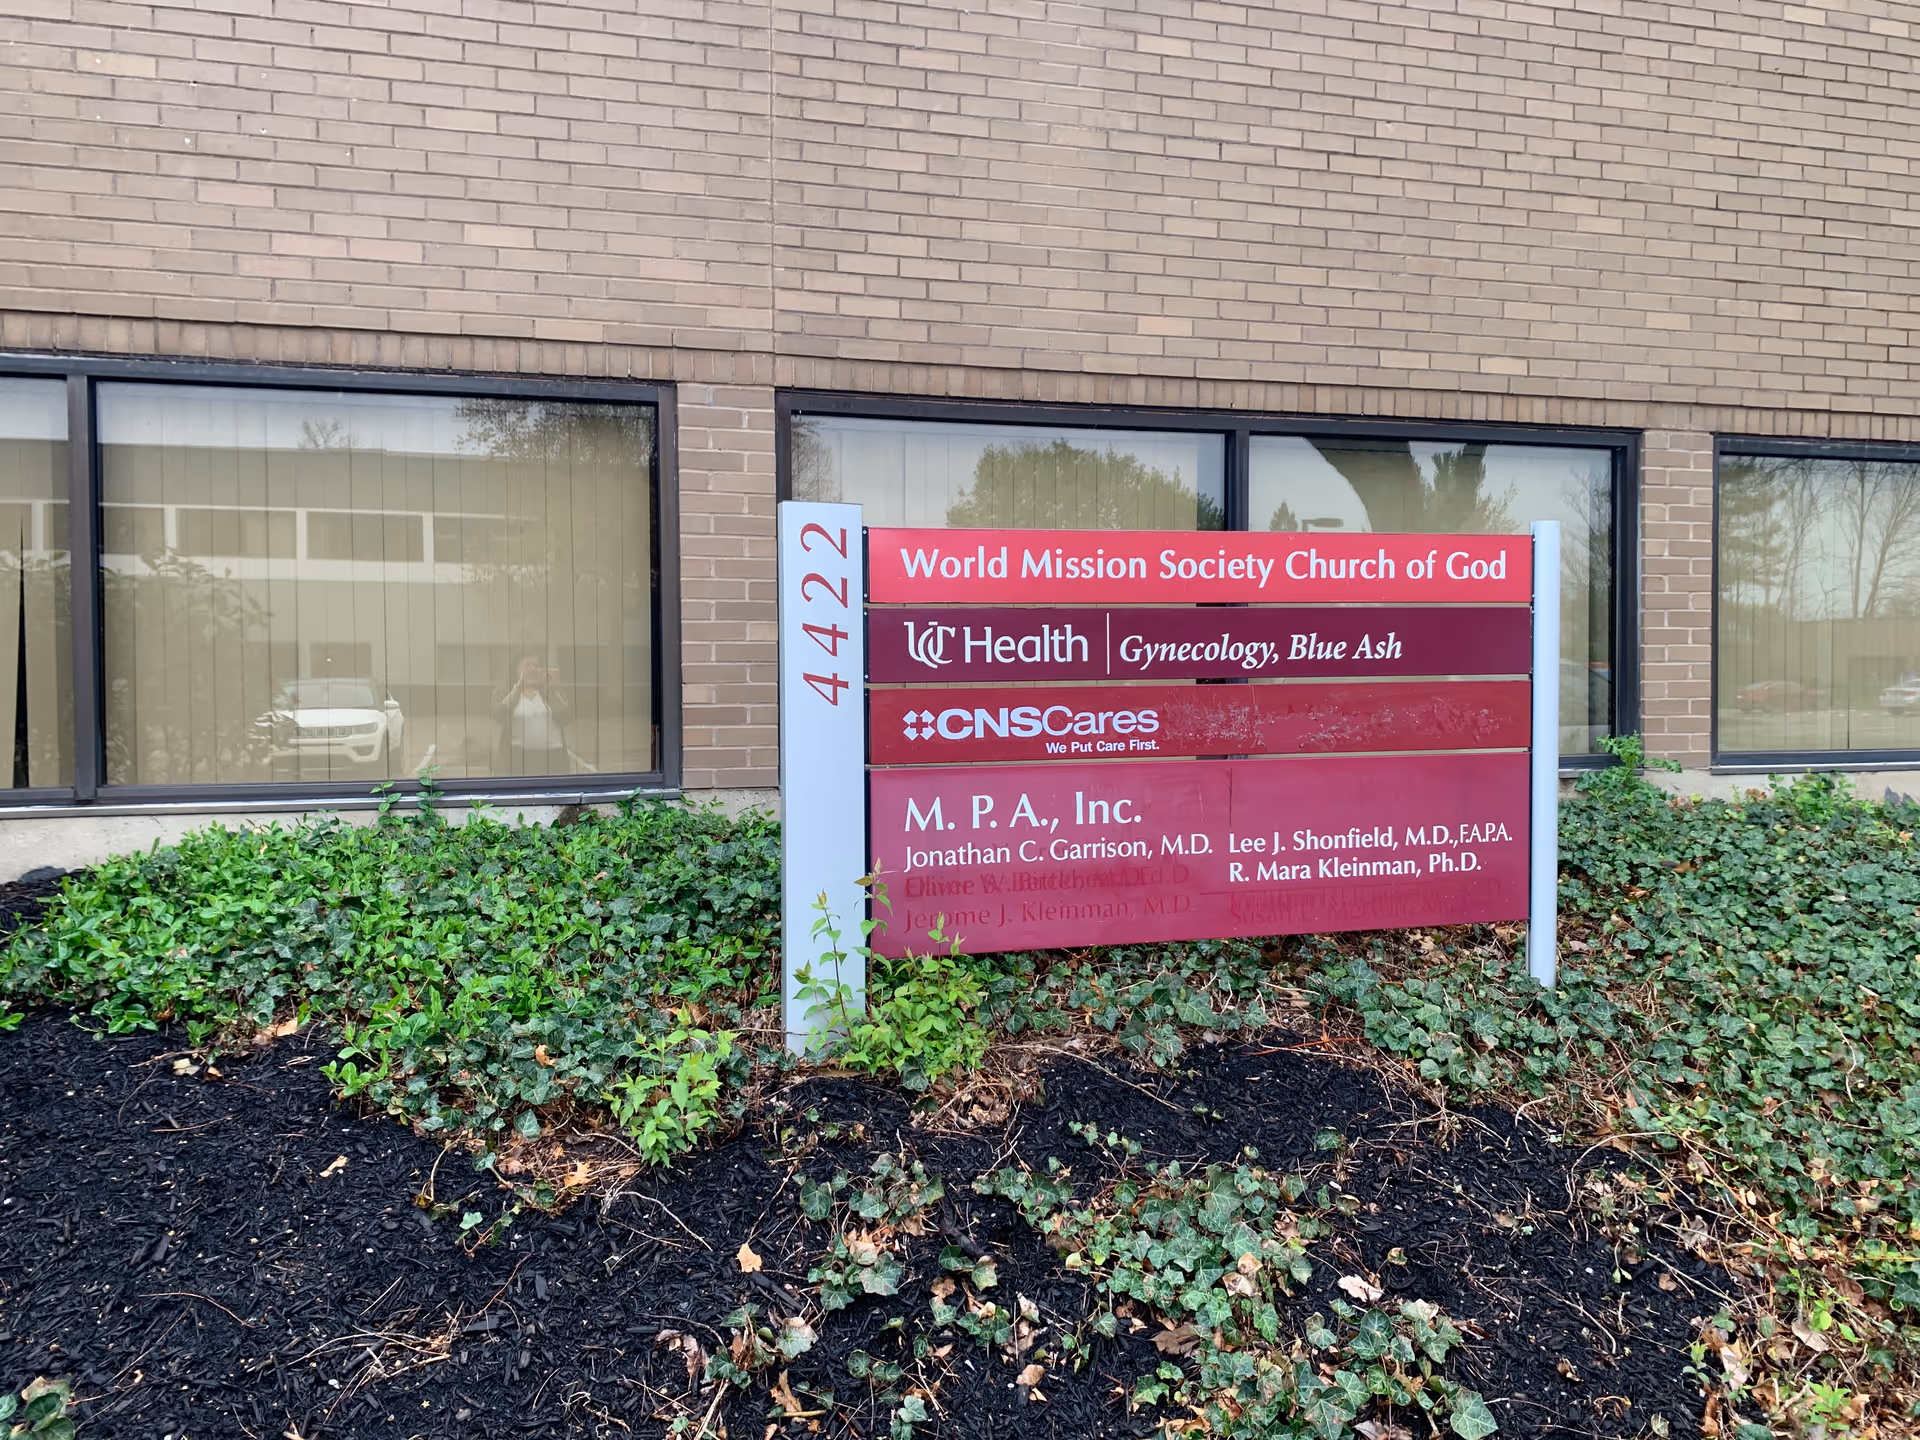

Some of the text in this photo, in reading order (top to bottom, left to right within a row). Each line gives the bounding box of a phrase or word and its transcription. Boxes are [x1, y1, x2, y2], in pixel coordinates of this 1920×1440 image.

[900, 545, 1507, 589] World Mission Society Church of God
[801, 522, 849, 706] 4422
[903, 621, 1402, 671] UC Health Gynecology, Blue Ash
[936, 705, 1160, 740] CNSCares
[1045, 738, 1160, 754] We Put Care First.
[904, 791, 1142, 834] M. P. A., Inc.
[904, 833, 1214, 873] Jonathan C. Garrison, M.D.
[1229, 833, 1266, 853] Lee
[1271, 831, 1286, 855] J.
[1293, 826, 1398, 851] Shonfield,
[1229, 851, 1482, 882] R. Mara Kleinman, Ph.D.
